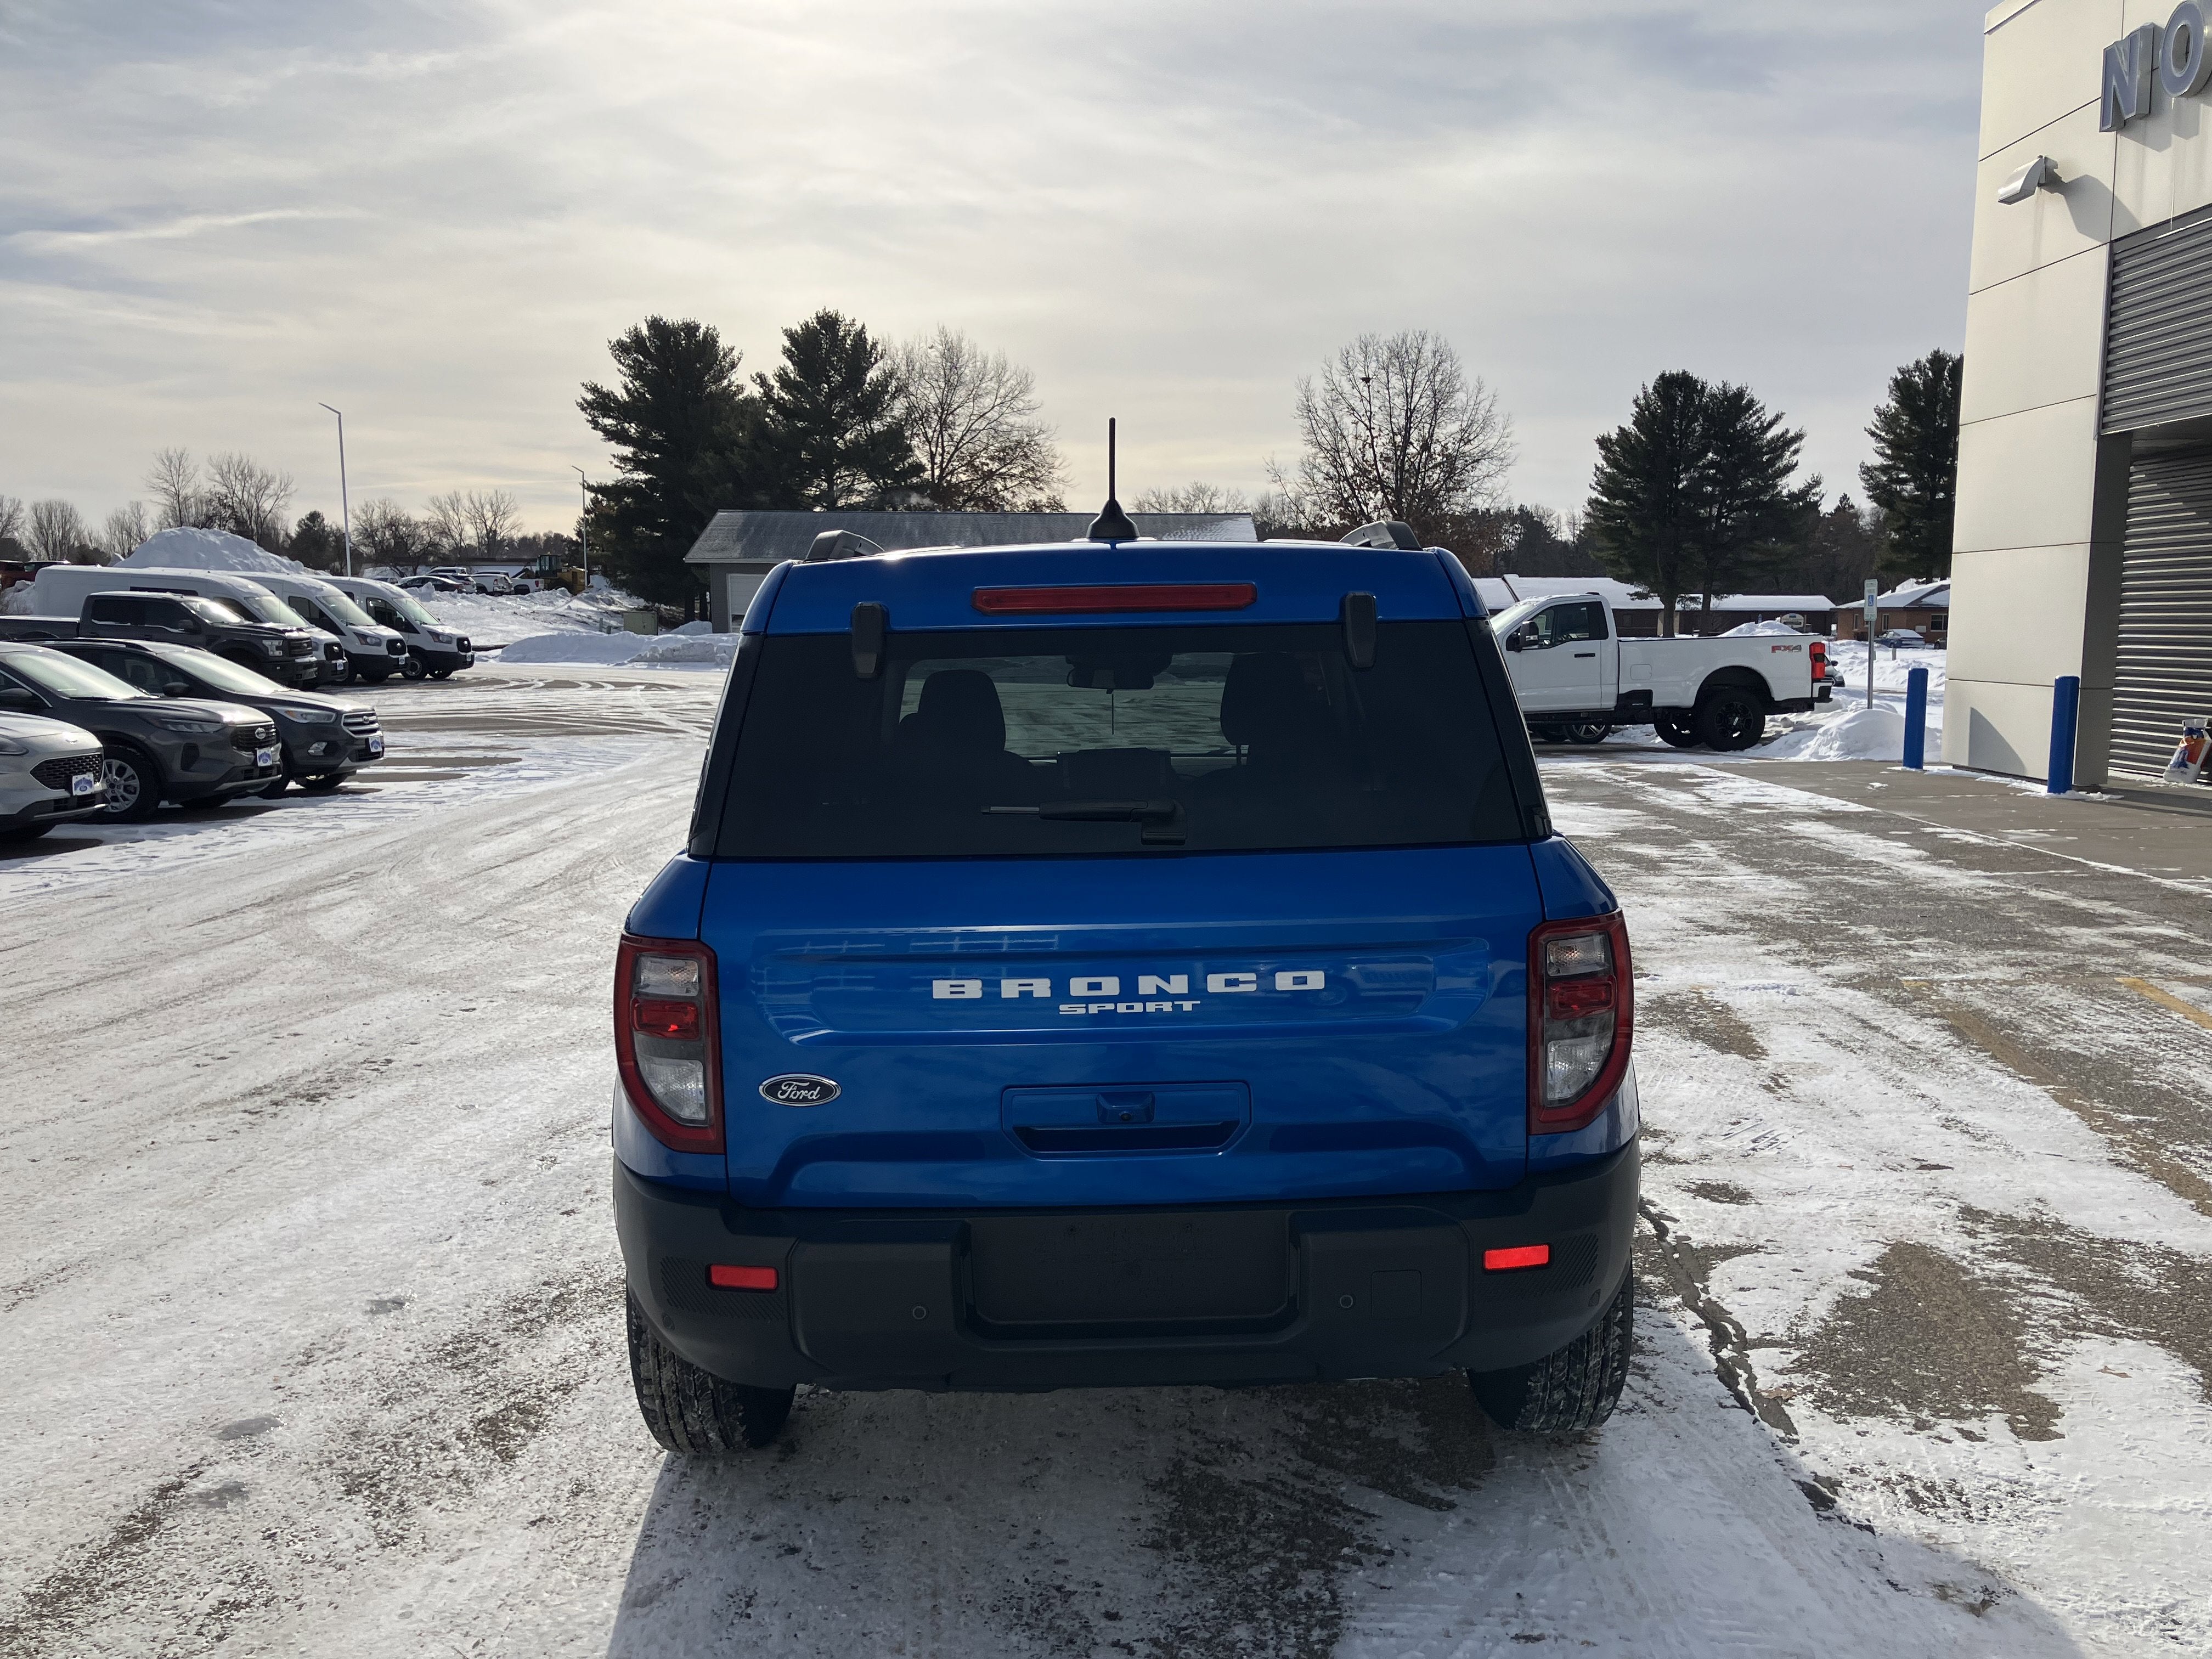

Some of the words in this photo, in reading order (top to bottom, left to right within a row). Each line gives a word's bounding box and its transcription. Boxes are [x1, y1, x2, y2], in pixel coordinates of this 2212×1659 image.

[1771, 645, 1802, 653] FX4
[933, 970, 1325, 998] BRONCO
[1059, 1001, 1200, 1014] SPORT
[777, 1081, 821, 1099] Ford
